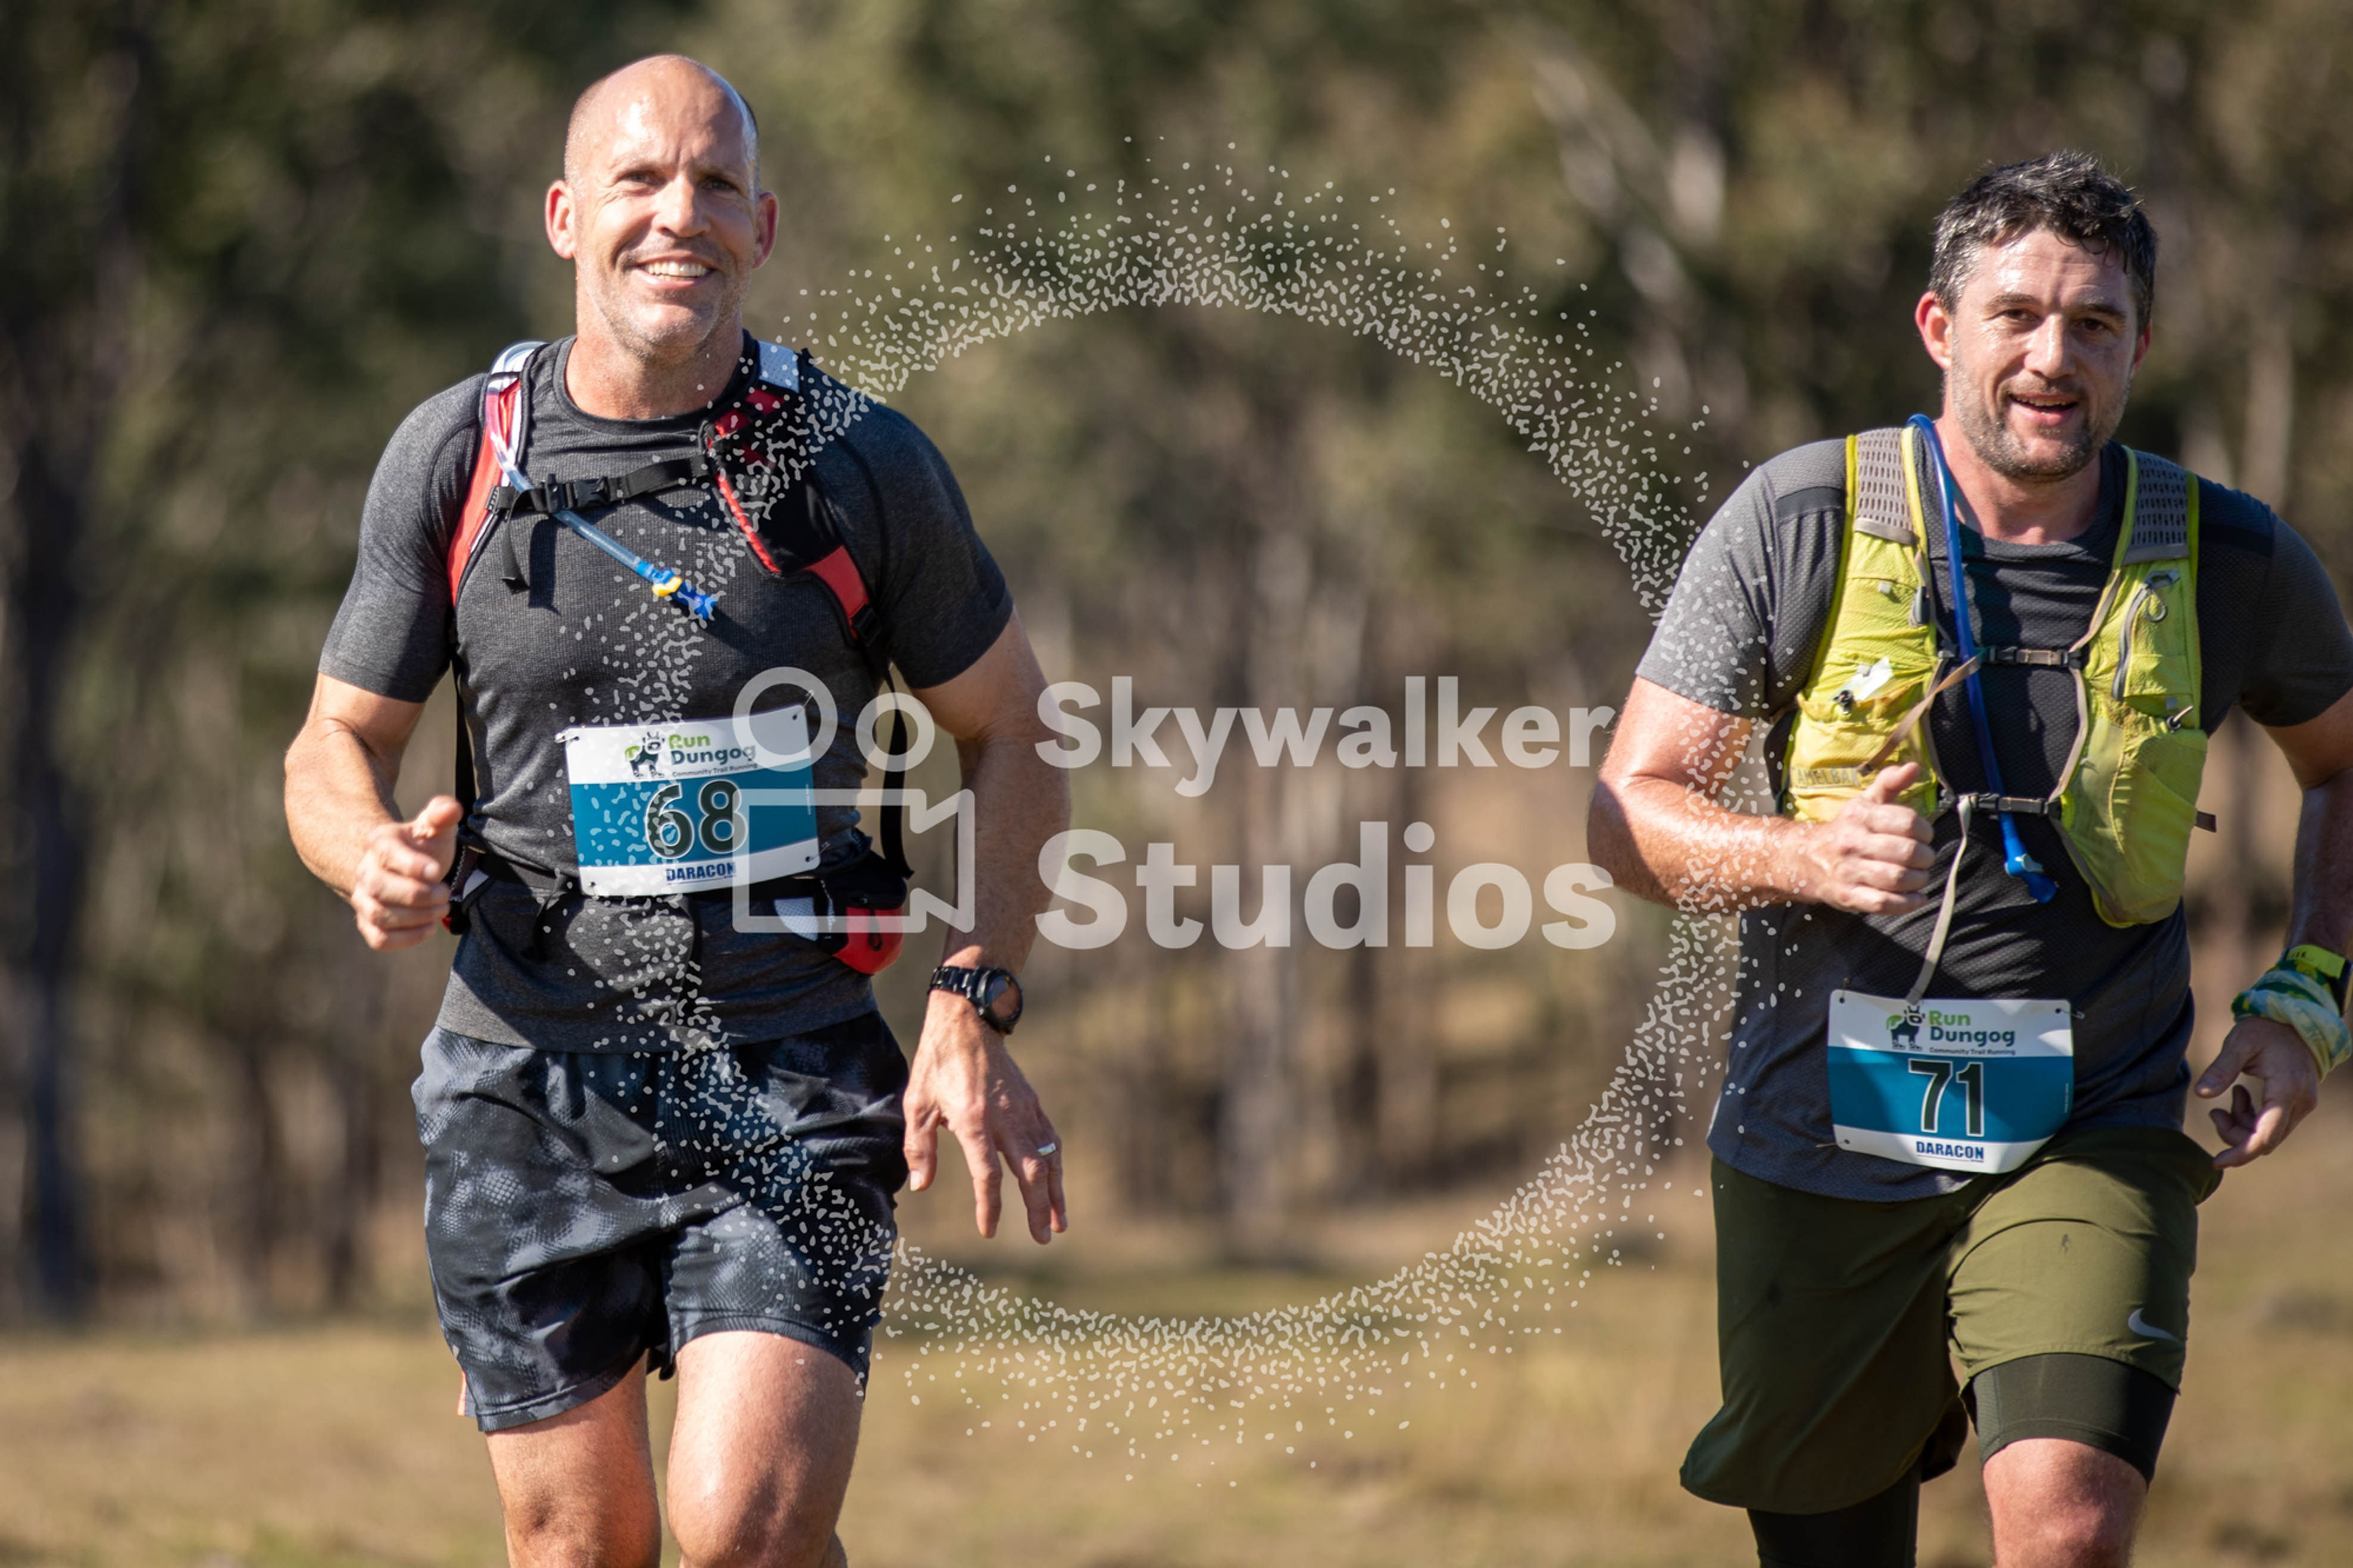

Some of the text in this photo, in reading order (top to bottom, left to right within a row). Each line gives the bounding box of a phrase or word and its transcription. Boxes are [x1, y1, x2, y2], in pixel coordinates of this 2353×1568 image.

[669, 734, 710, 749] Run
[671, 746, 756, 765] Dungog
[672, 768, 712, 777] Community
[729, 763, 758, 772] Running
[645, 779, 748, 859] 68
[665, 862, 736, 881] DARACON
[1929, 1010, 1971, 1026] Run
[1930, 1026, 2015, 1047] Dungog
[1929, 1047, 1970, 1056] Community
[1908, 1058, 1985, 1137] 71
[1916, 1141, 1985, 1160] DARACON
